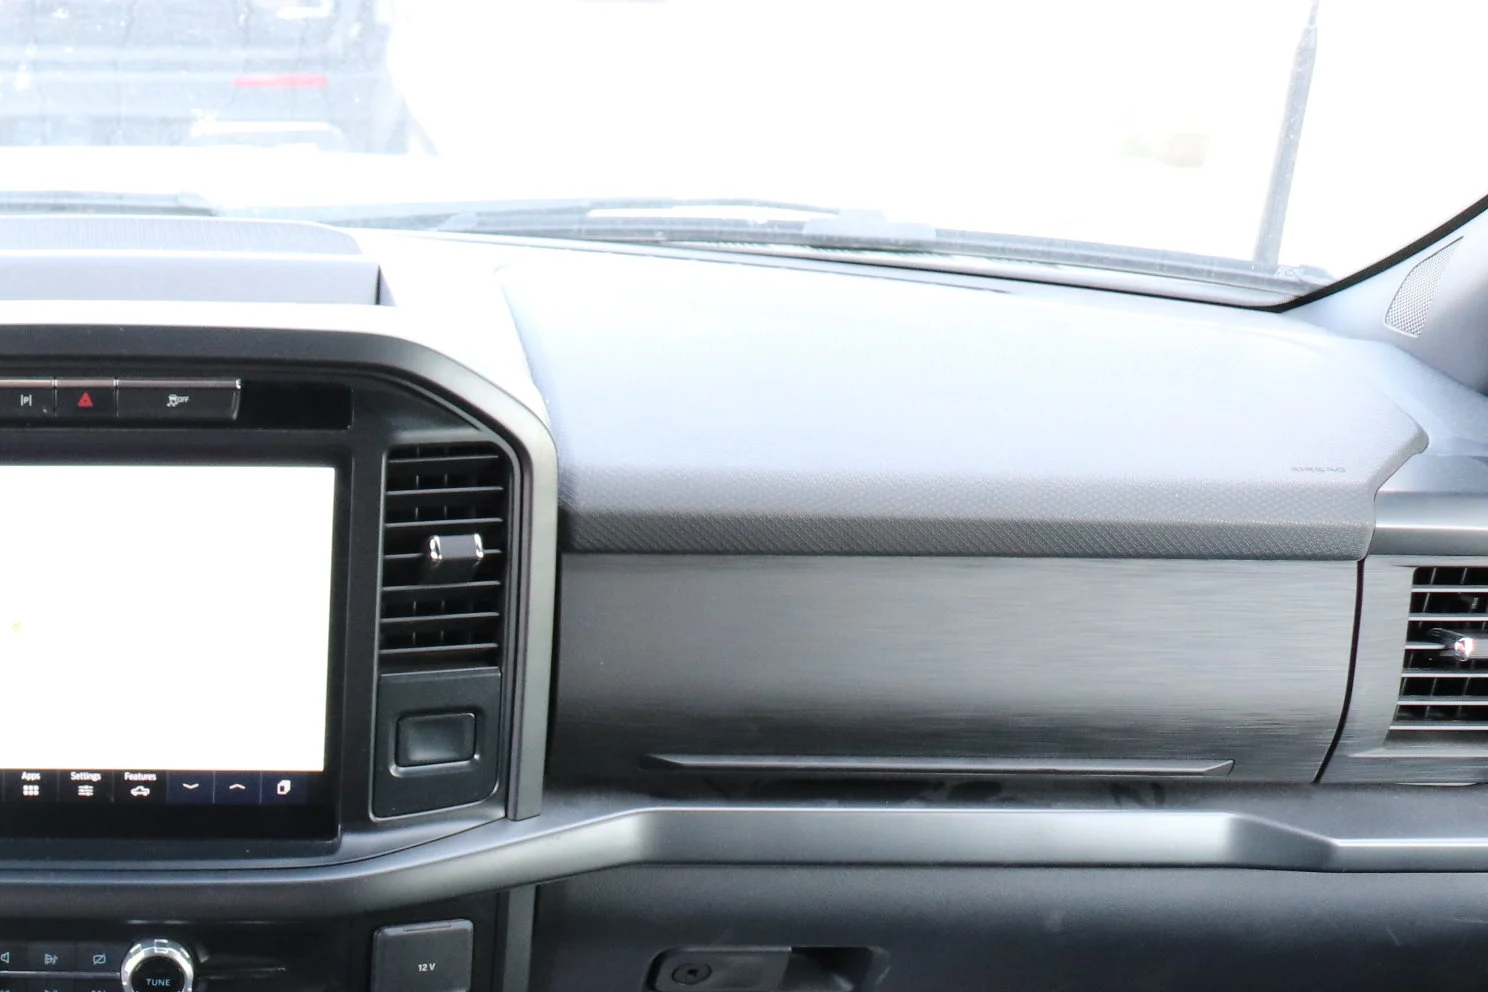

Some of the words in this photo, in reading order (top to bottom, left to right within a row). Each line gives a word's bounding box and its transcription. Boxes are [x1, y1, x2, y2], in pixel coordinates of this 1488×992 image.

[21, 771, 41, 781] Apps
[70, 771, 102, 782] Settings
[124, 771, 157, 781] Features
[418, 964, 428, 972] 12
[429, 963, 436, 971] V
[146, 978, 171, 987] TUNE
